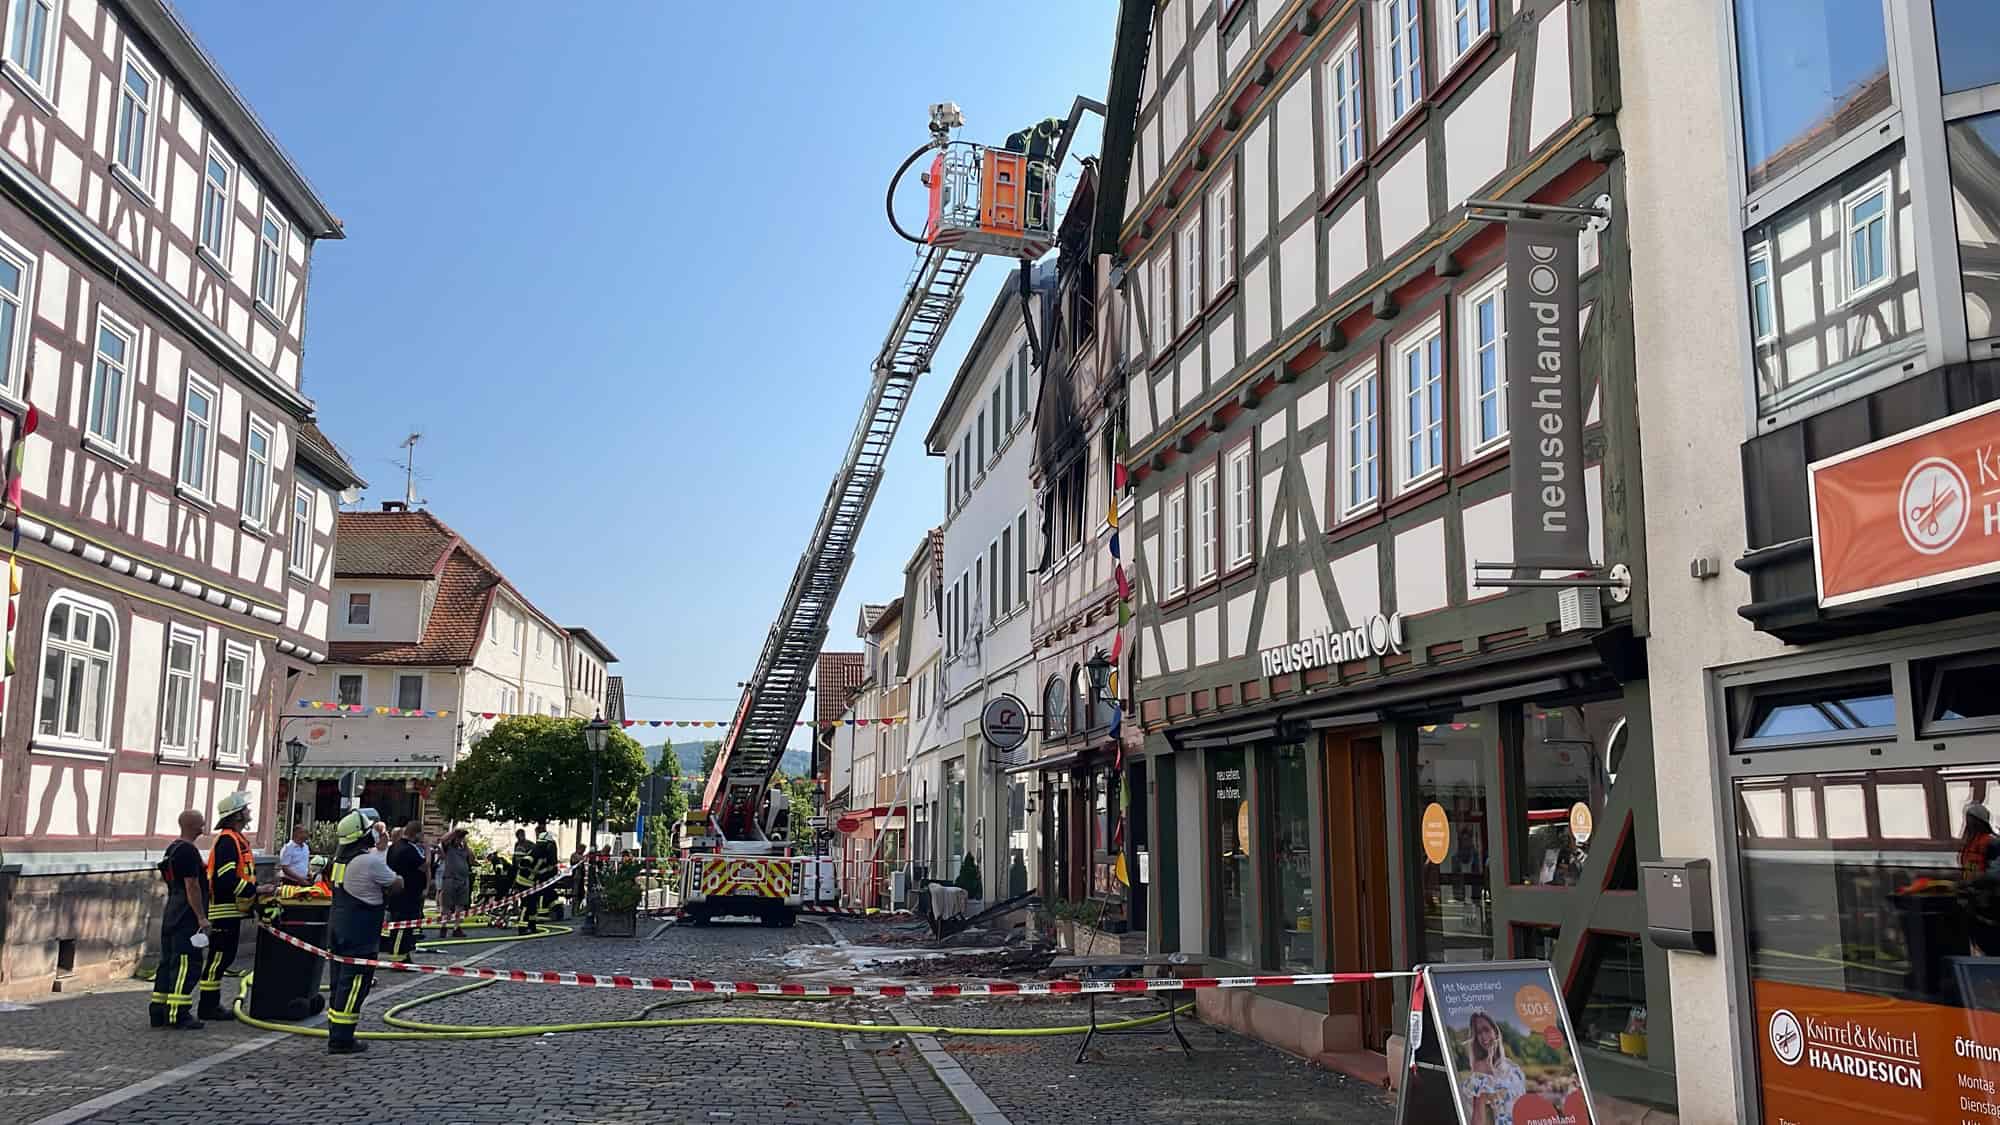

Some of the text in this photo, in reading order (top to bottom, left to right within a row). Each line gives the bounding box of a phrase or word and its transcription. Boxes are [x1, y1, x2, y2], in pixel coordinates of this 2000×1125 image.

[1529, 302, 1568, 533] neusehland
[1261, 616, 1371, 677] neusehland
[1808, 1048, 1922, 1089] HAARDESIGN
[1958, 1073, 1996, 1095] Montag
